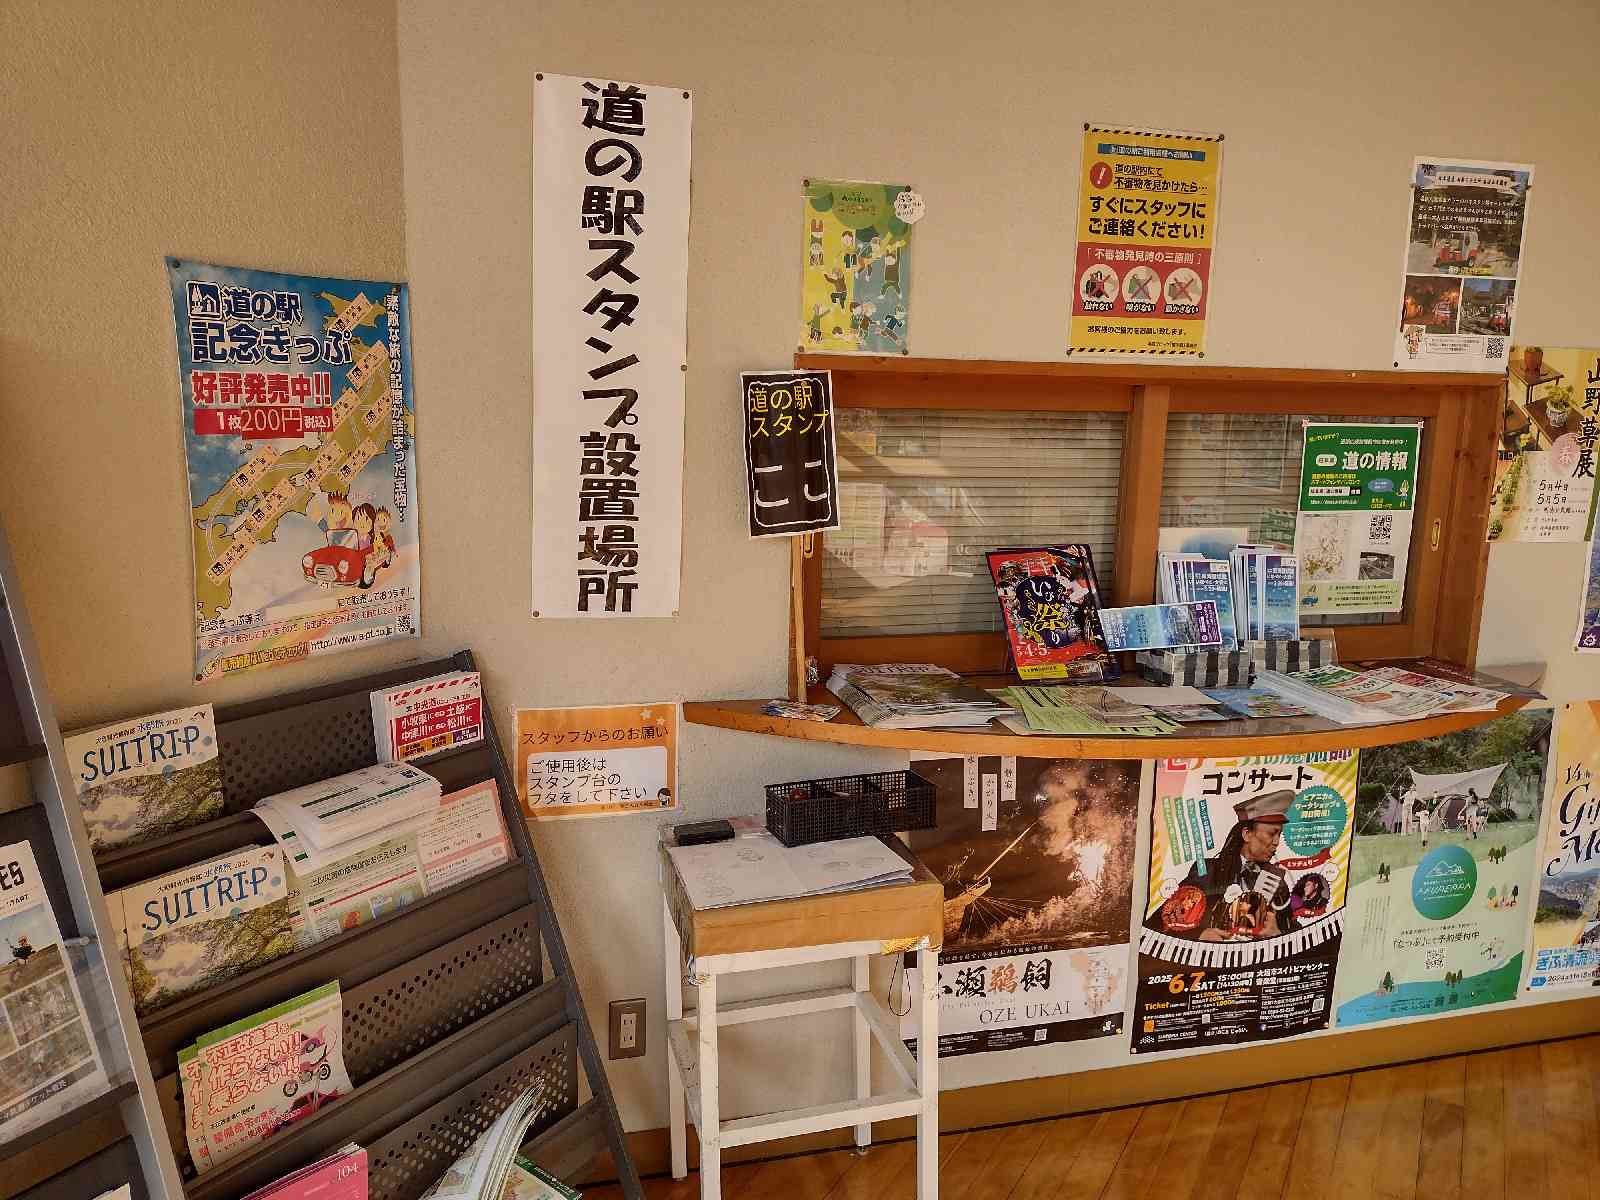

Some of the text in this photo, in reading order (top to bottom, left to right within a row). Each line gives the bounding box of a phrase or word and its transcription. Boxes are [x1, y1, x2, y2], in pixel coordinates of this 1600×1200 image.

[1114, 163, 1164, 177] 道の駅内にて
[1089, 196, 1206, 219] すぐにスタッフに
[223, 286, 302, 326] 道の駅
[191, 322, 353, 365] 記念きっぷ
[578, 81, 648, 612] 道の駅スタンプ設置場所
[751, 381, 813, 414] 道の駅
[752, 408, 829, 438] スタンプ
[1342, 450, 1408, 471] 道の情報
[754, 460, 827, 507] ここ
[522, 726, 669, 745] スタッフからのお願い
[82, 724, 200, 781] SUITRIP
[529, 757, 607, 774] ご使用後は
[529, 773, 621, 792] スタンプ台の
[1202, 766, 1313, 795] コンサート
[528, 786, 647, 805] フタをして下さい
[142, 866, 268, 931] SUITRIP
[1148, 974, 1172, 985] 2025
[1195, 980, 1216, 992] SAT
[979, 1000, 1071, 1025] OZE UKAI
[1145, 1001, 1169, 1012] Ticket
